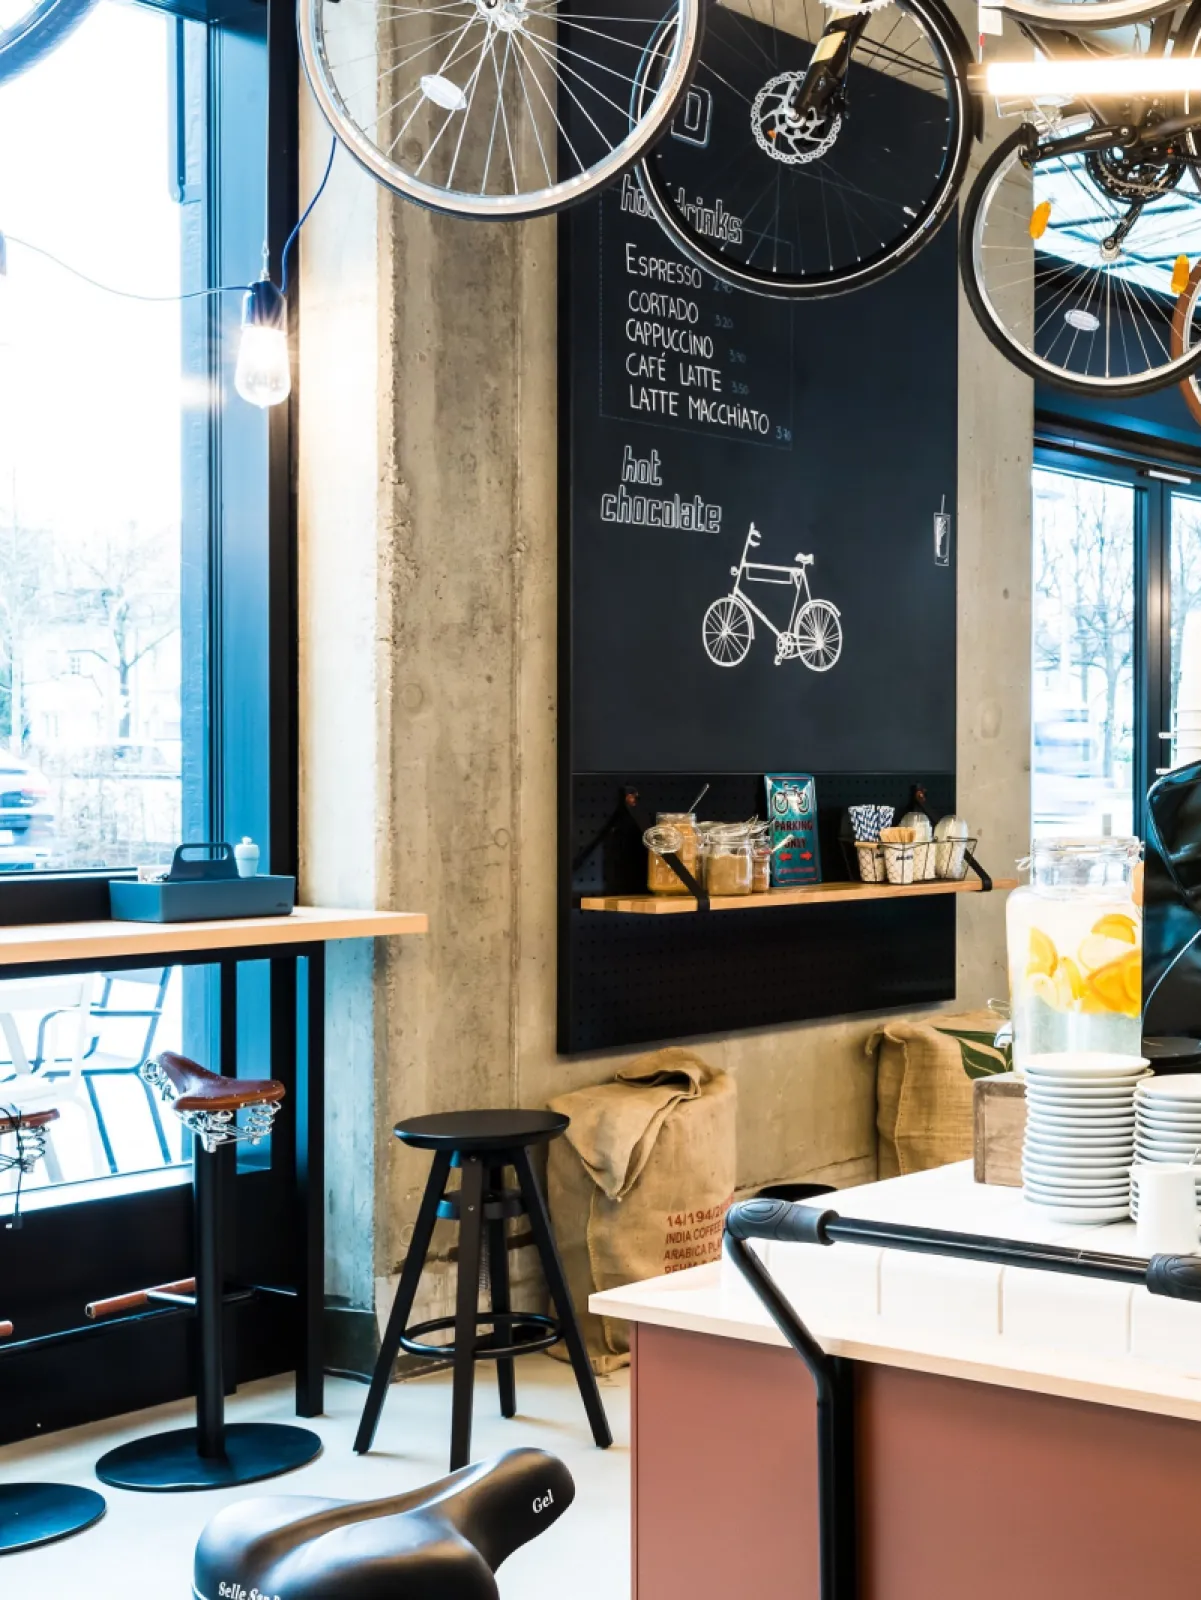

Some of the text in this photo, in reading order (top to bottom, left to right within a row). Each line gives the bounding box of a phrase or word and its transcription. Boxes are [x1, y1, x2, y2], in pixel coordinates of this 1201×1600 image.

[620, 173, 657, 220] ho
[625, 242, 702, 289] ESPRESSO
[628, 289, 699, 324] CORTADO
[625, 351, 666, 381] CAFÉ
[679, 362, 722, 392] LATTE
[629, 384, 679, 417] LATTE
[621, 443, 663, 486] hot
[601, 484, 722, 534] chocolate
[774, 820, 813, 831] PARKING
[664, 1244, 706, 1260] ARABICA
[666, 1230, 692, 1245] INDIA
[532, 1488, 554, 1514] Gel
[218, 1581, 246, 1600] Selle
